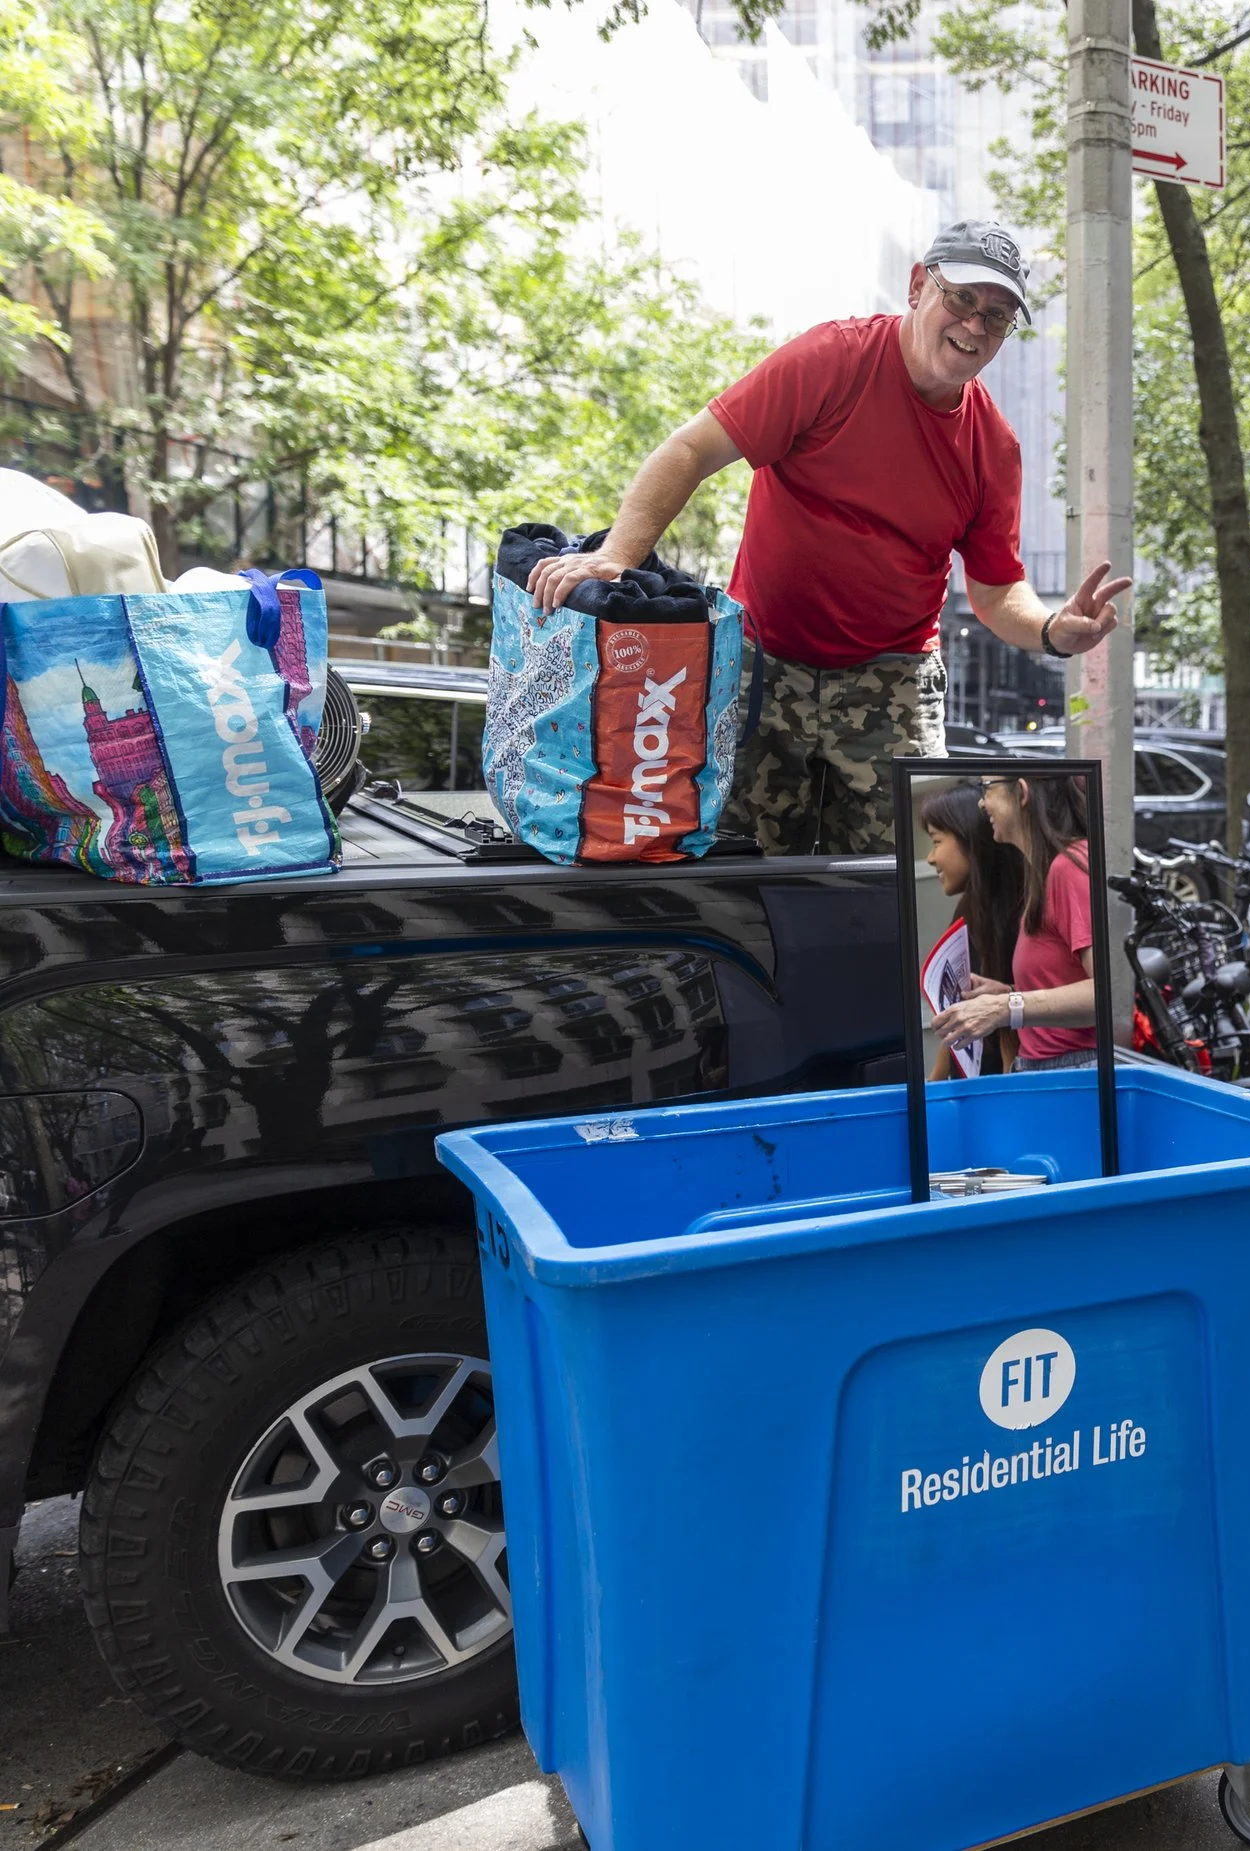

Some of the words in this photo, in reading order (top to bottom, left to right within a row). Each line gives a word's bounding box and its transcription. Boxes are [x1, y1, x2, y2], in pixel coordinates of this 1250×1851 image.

[1150, 101, 1190, 127] Friday
[614, 644, 642, 659] 100%
[1001, 1351, 1058, 1408] FIT
[901, 1430, 1081, 1513] Residential
[1092, 1419, 1146, 1466] Life
[385, 1500, 425, 1520] GMC
